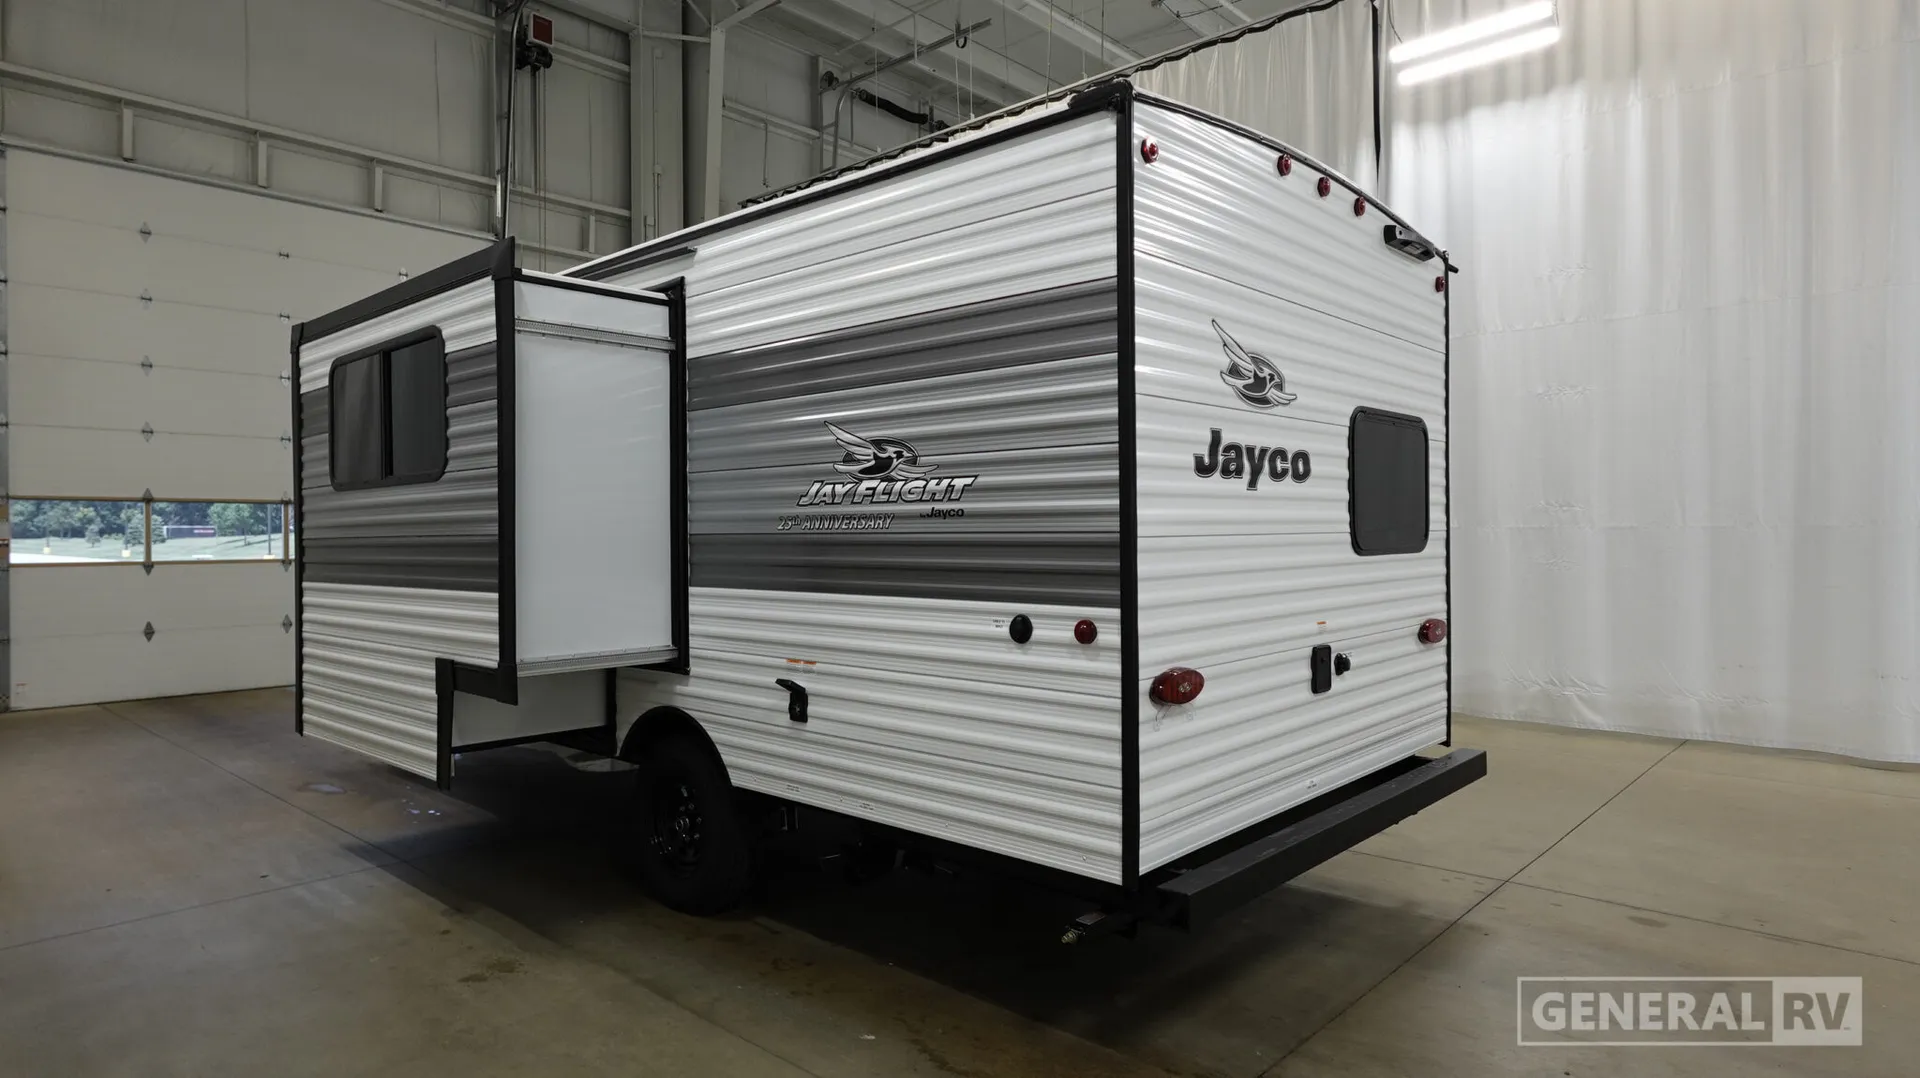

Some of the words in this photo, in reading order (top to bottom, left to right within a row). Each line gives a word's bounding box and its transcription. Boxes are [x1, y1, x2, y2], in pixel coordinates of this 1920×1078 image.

[1193, 428, 1311, 491] Jayco
[796, 480, 856, 506] JAY
[852, 474, 980, 504] FLIGHT
[776, 514, 801, 531] 25th
[801, 512, 895, 531] ANNIVERSARY
[927, 506, 965, 520] Jayco
